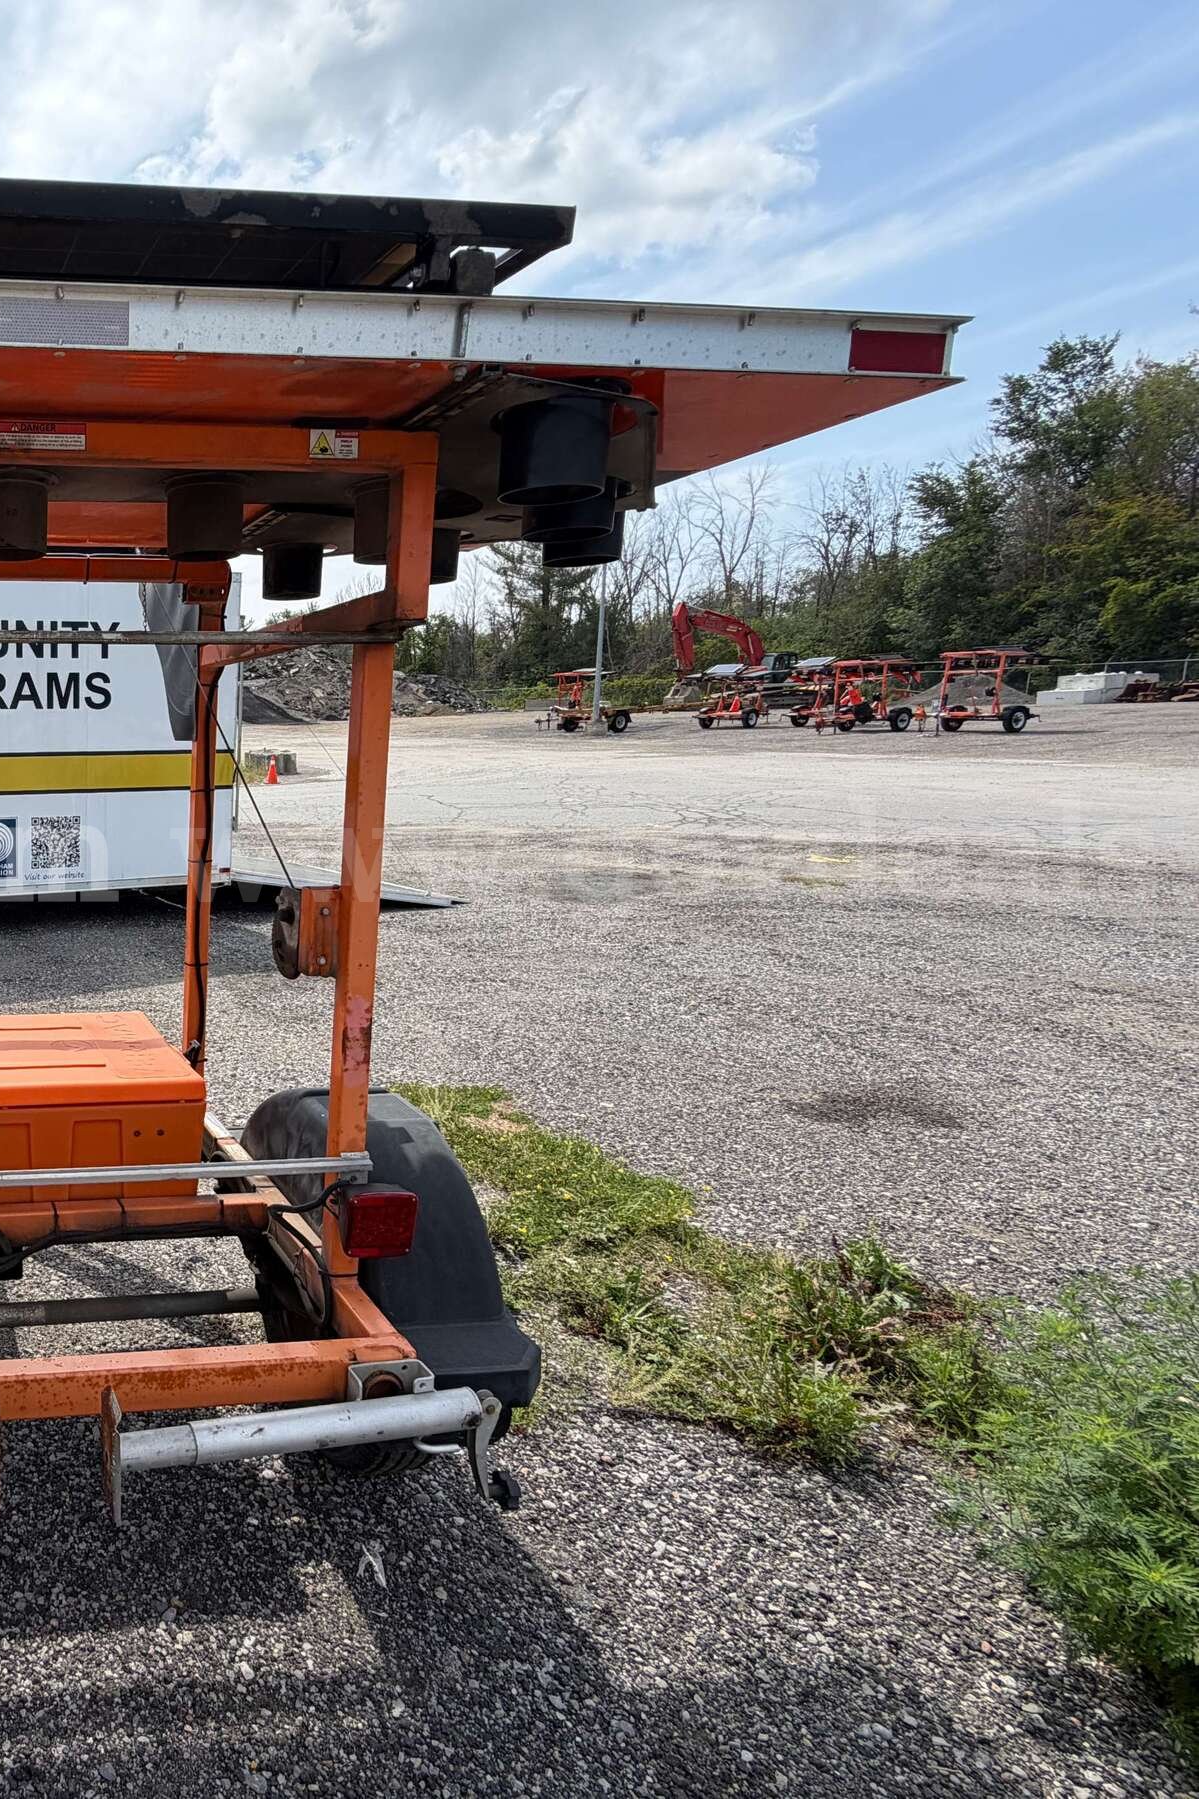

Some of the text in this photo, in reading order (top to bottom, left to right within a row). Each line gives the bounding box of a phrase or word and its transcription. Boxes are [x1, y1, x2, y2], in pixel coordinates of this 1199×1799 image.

[19, 423, 57, 432] DANGER
[24, 872, 40, 881] Visit
[58, 871, 85, 879] website
